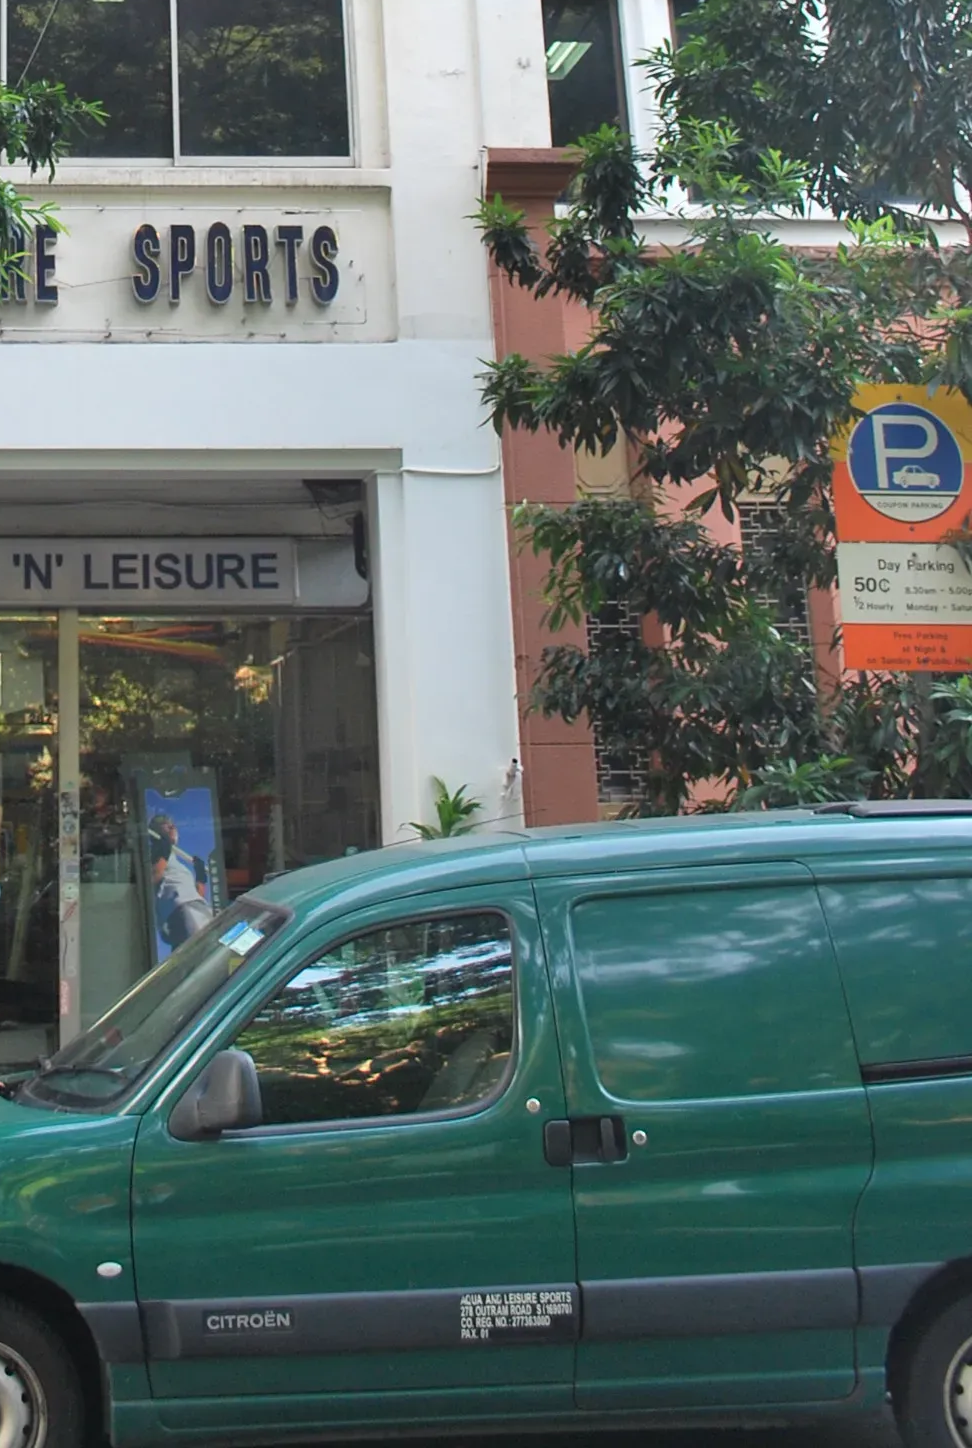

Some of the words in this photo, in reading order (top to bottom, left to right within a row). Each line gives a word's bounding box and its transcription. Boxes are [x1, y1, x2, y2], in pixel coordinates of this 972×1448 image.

[132, 222, 340, 306] SPORTS
[872, 414, 938, 488] P
[876, 501, 908, 509] COUPON
[911, 501, 944, 509] PARKING
[13, 553, 63, 589] 'N'
[84, 553, 280, 589] LEISURE
[878, 559, 900, 573] Day
[908, 559, 955, 573] Parking
[866, 603, 894, 612] Hourly
[906, 603, 938, 612] Monday
[916, 631, 949, 641] Parking
[460, 1295, 483, 1305] AQUA
[485, 1294, 502, 1305] AND
[504, 1293, 538, 1304] LEISURE
[539, 1291, 572, 1303] SPORTS
[475, 1305, 509, 1316] OUTRAM
[510, 1304, 532, 1315] ROAD
[206, 1309, 291, 1331] CITROËN
[461, 1317, 473, 1328] CO.
[476, 1317, 494, 1328] REG.
[480, 1328, 489, 1338] 01
